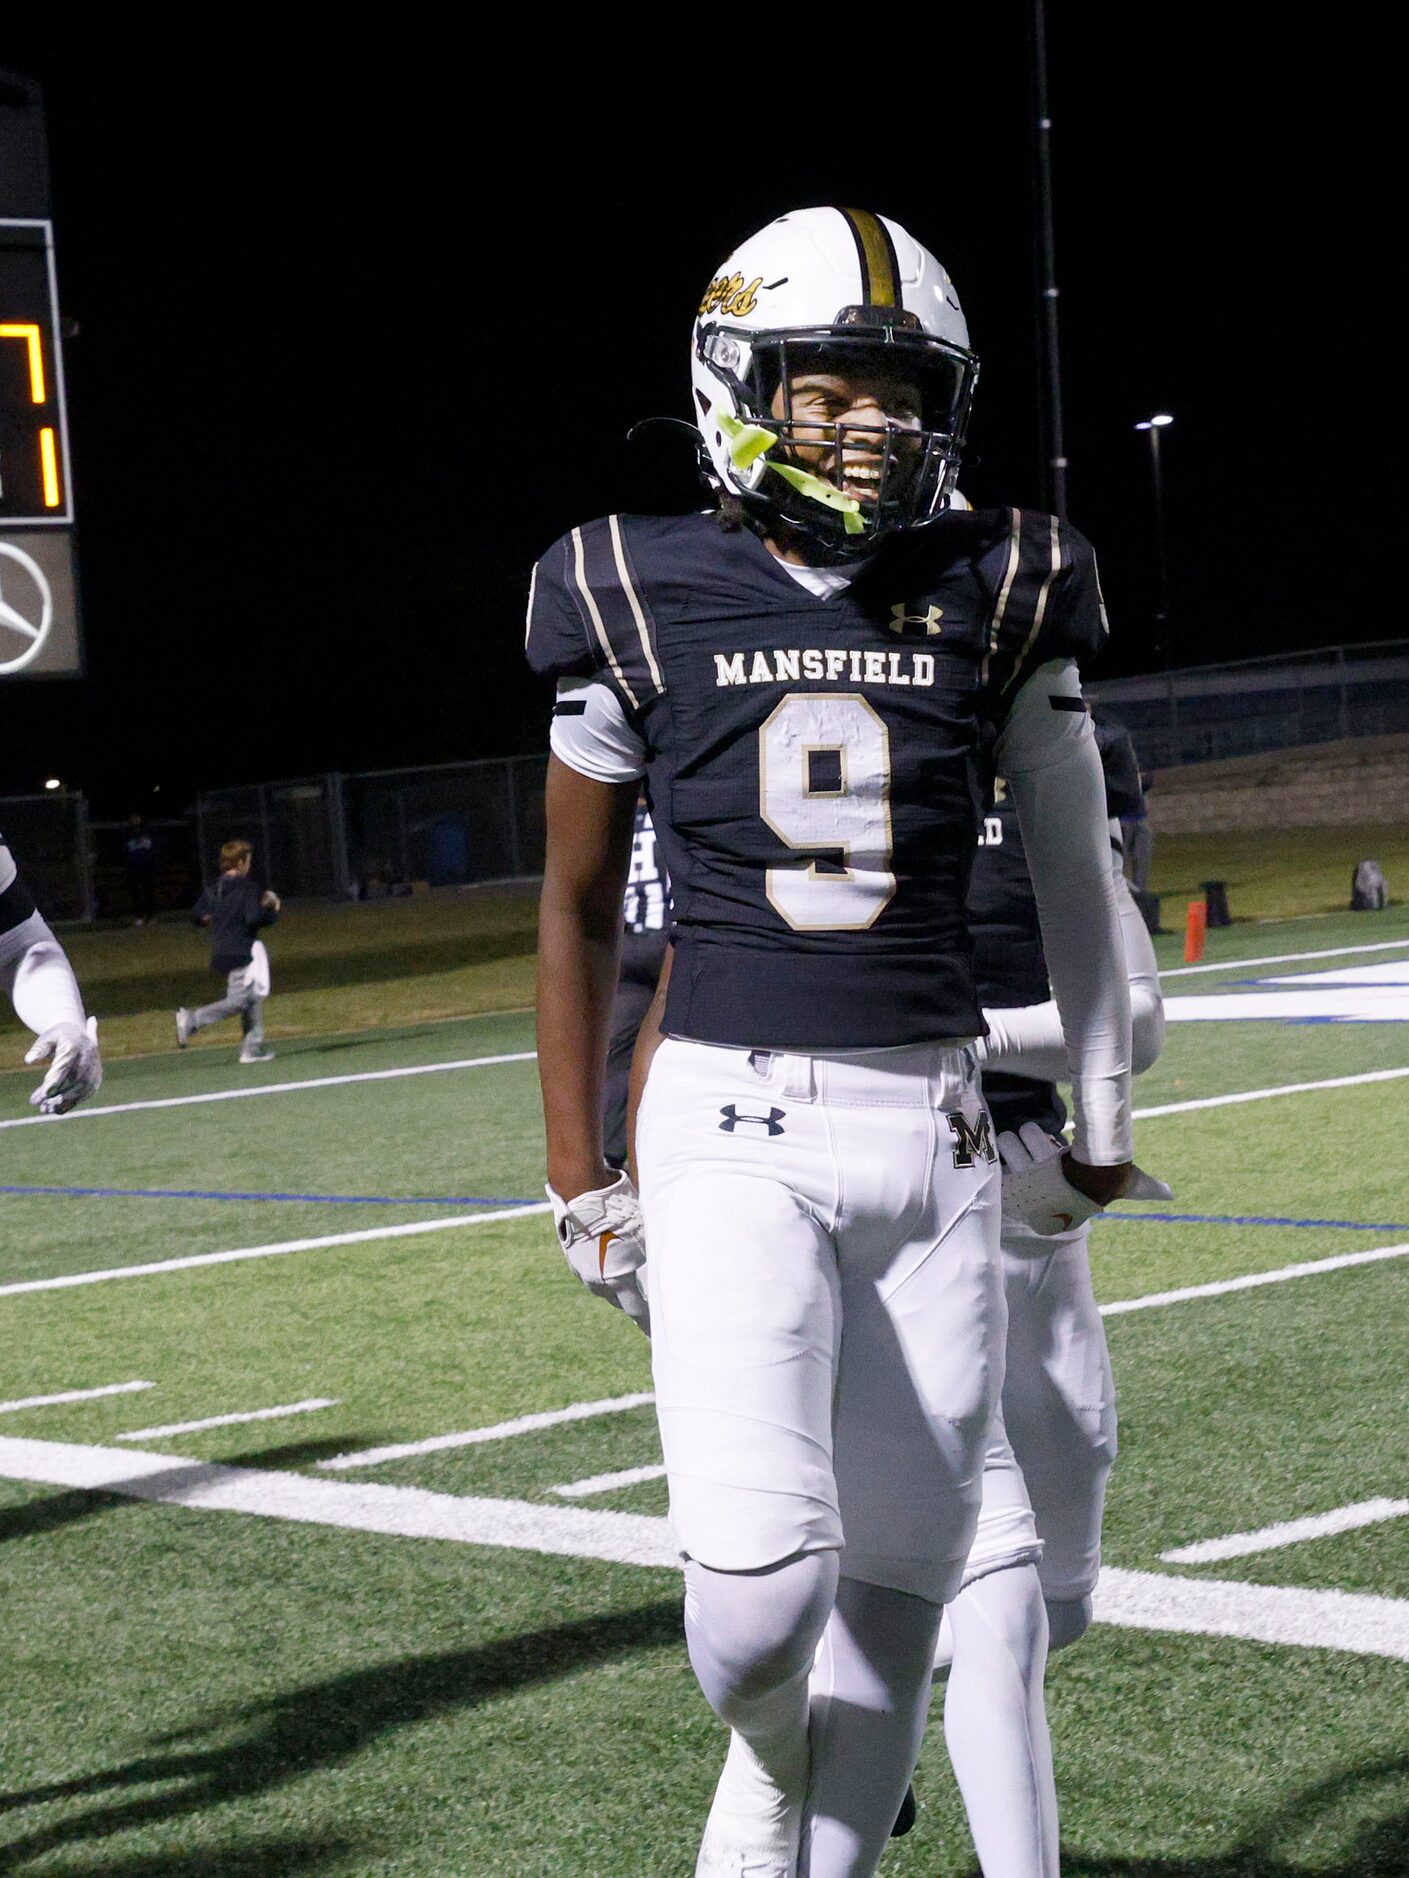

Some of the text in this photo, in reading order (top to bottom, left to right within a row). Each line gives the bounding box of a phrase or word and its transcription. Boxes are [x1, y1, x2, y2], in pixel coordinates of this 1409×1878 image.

[40, 427, 60, 507] 1
[713, 649, 936, 687] MANSFIELD
[759, 692, 898, 931] 9
[945, 1108, 998, 1169] M
